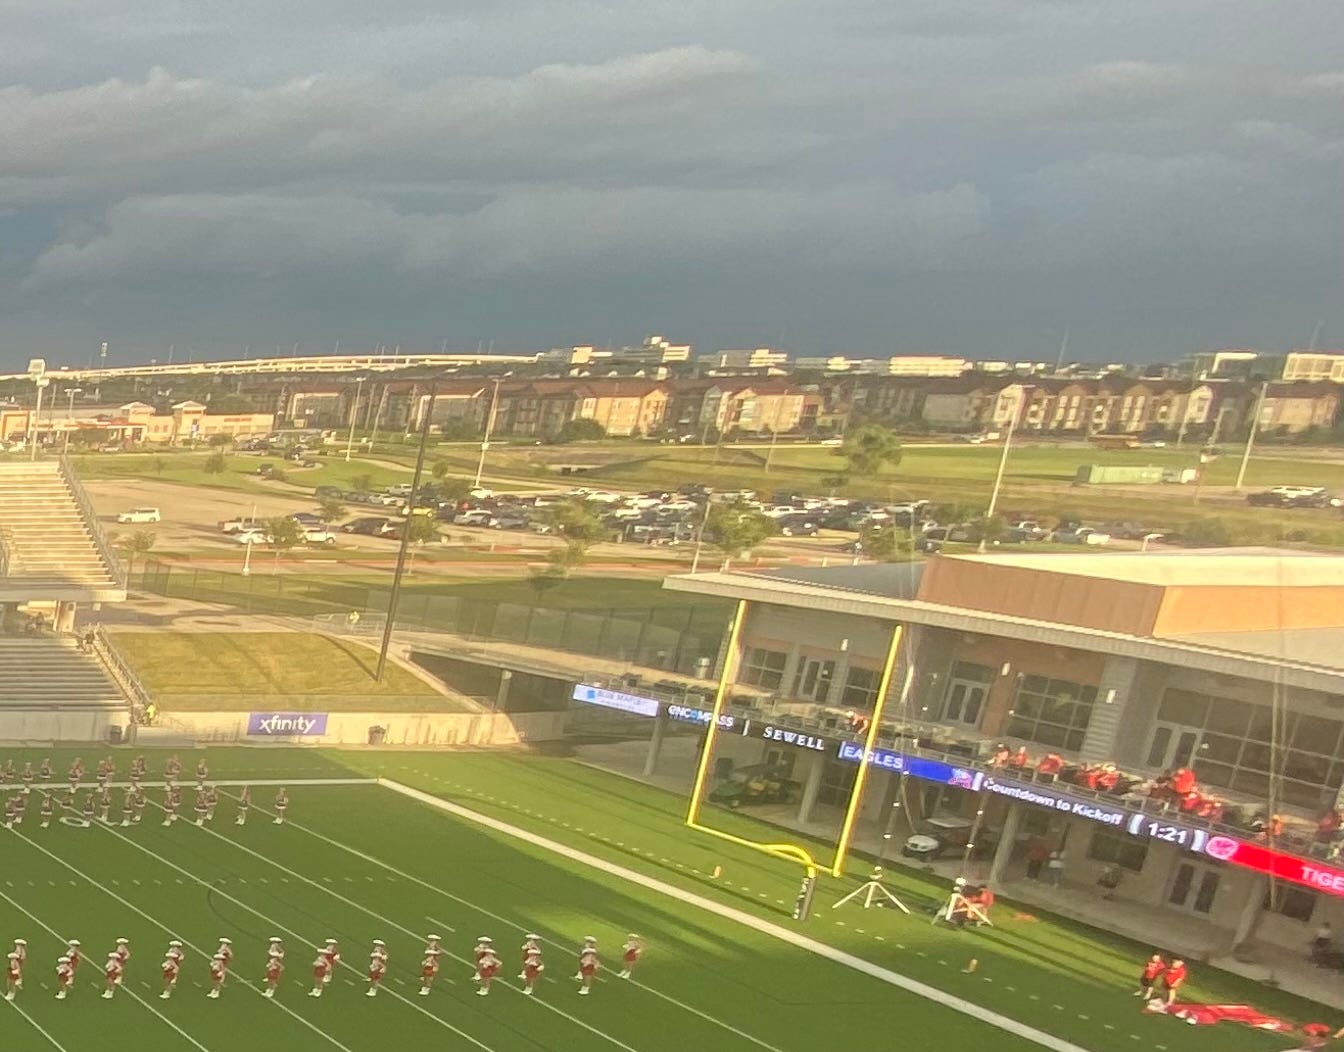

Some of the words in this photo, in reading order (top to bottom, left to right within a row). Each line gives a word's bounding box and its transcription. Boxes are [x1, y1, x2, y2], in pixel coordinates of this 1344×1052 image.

[258, 714, 316, 734] xfinity
[763, 726, 824, 750] SEWELL
[983, 777, 1055, 806] Countdown
[1056, 799, 1071, 811] to
[1072, 803, 1123, 825] Kickoff
[1149, 822, 1187, 844] 1:21
